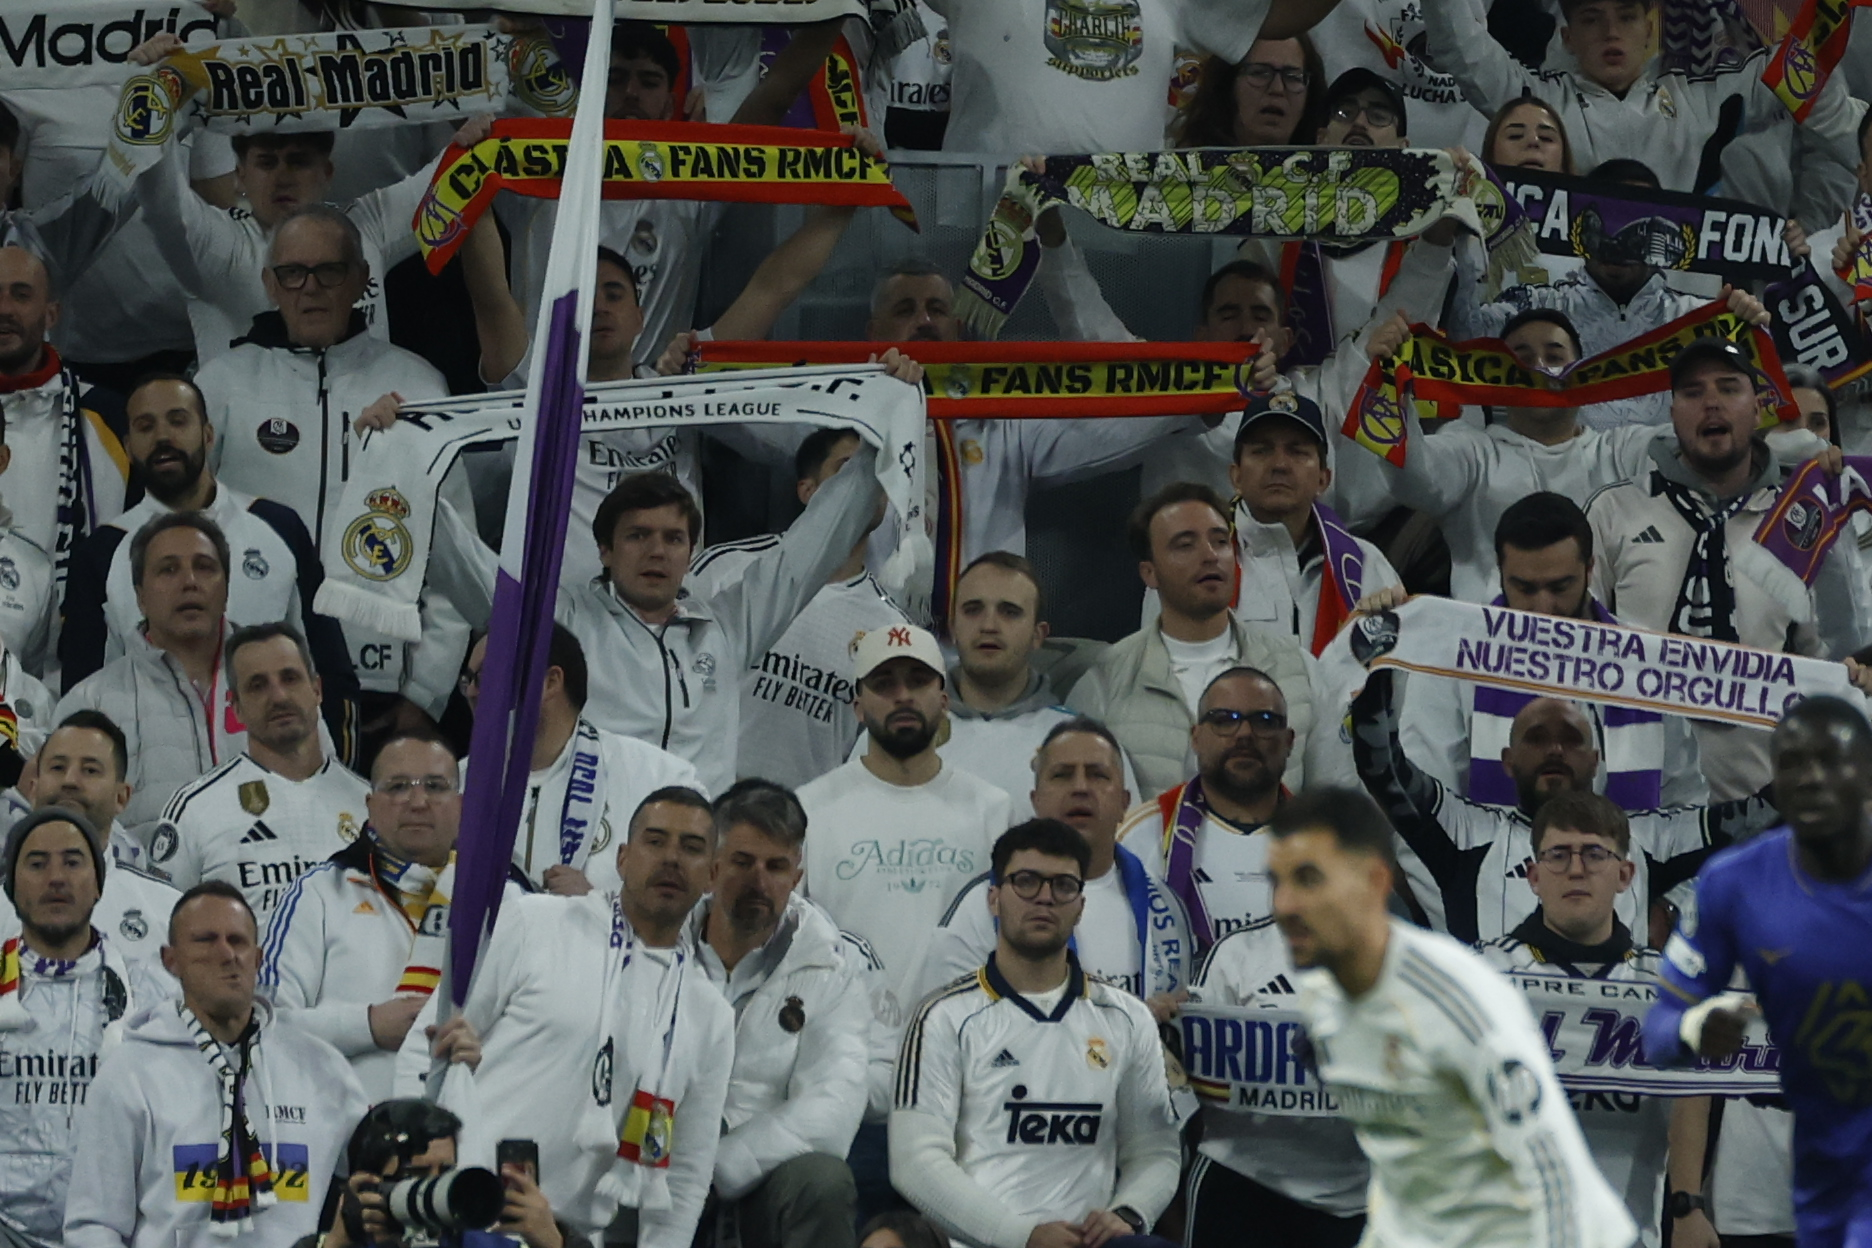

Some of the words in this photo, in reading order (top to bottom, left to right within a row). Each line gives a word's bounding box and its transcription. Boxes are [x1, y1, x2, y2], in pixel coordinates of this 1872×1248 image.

[0, 6, 223, 68] Madrid
[1056, 9, 1132, 44] CHARLIE
[207, 60, 303, 112] Real
[323, 41, 487, 102] Madrid
[889, 77, 952, 106] irates
[457, 136, 633, 201] CLÁSIA
[669, 145, 771, 181] FANS
[777, 148, 875, 182] RMCF
[1091, 152, 1210, 184] REAL
[1066, 184, 1380, 237] MADRID
[1698, 209, 1791, 268] FON
[1779, 289, 1850, 374] SUR
[981, 362, 1088, 397] FANS
[1105, 362, 1229, 395] RMCF
[1409, 338, 1535, 389] ASICA
[1577, 334, 1684, 387] FANS
[584, 403, 695, 422] HAMPIONS
[704, 401, 781, 418] LEAGUE
[1813, 463, 1872, 513] LA
[1456, 638, 1625, 693] NUESTRO
[1480, 607, 1647, 663] VUESTRA
[1660, 639, 1796, 686] ENVIDIA
[750, 650, 861, 705] mirates
[752, 677, 781, 702] FLY
[783, 685, 834, 725] BETTER
[836, 837, 975, 880] Adidas
[0, 1049, 99, 1079] Emirat
[14, 1081, 43, 1106] FLY
[48, 1081, 90, 1107] BETT
[1003, 1085, 1104, 1144] Teka
